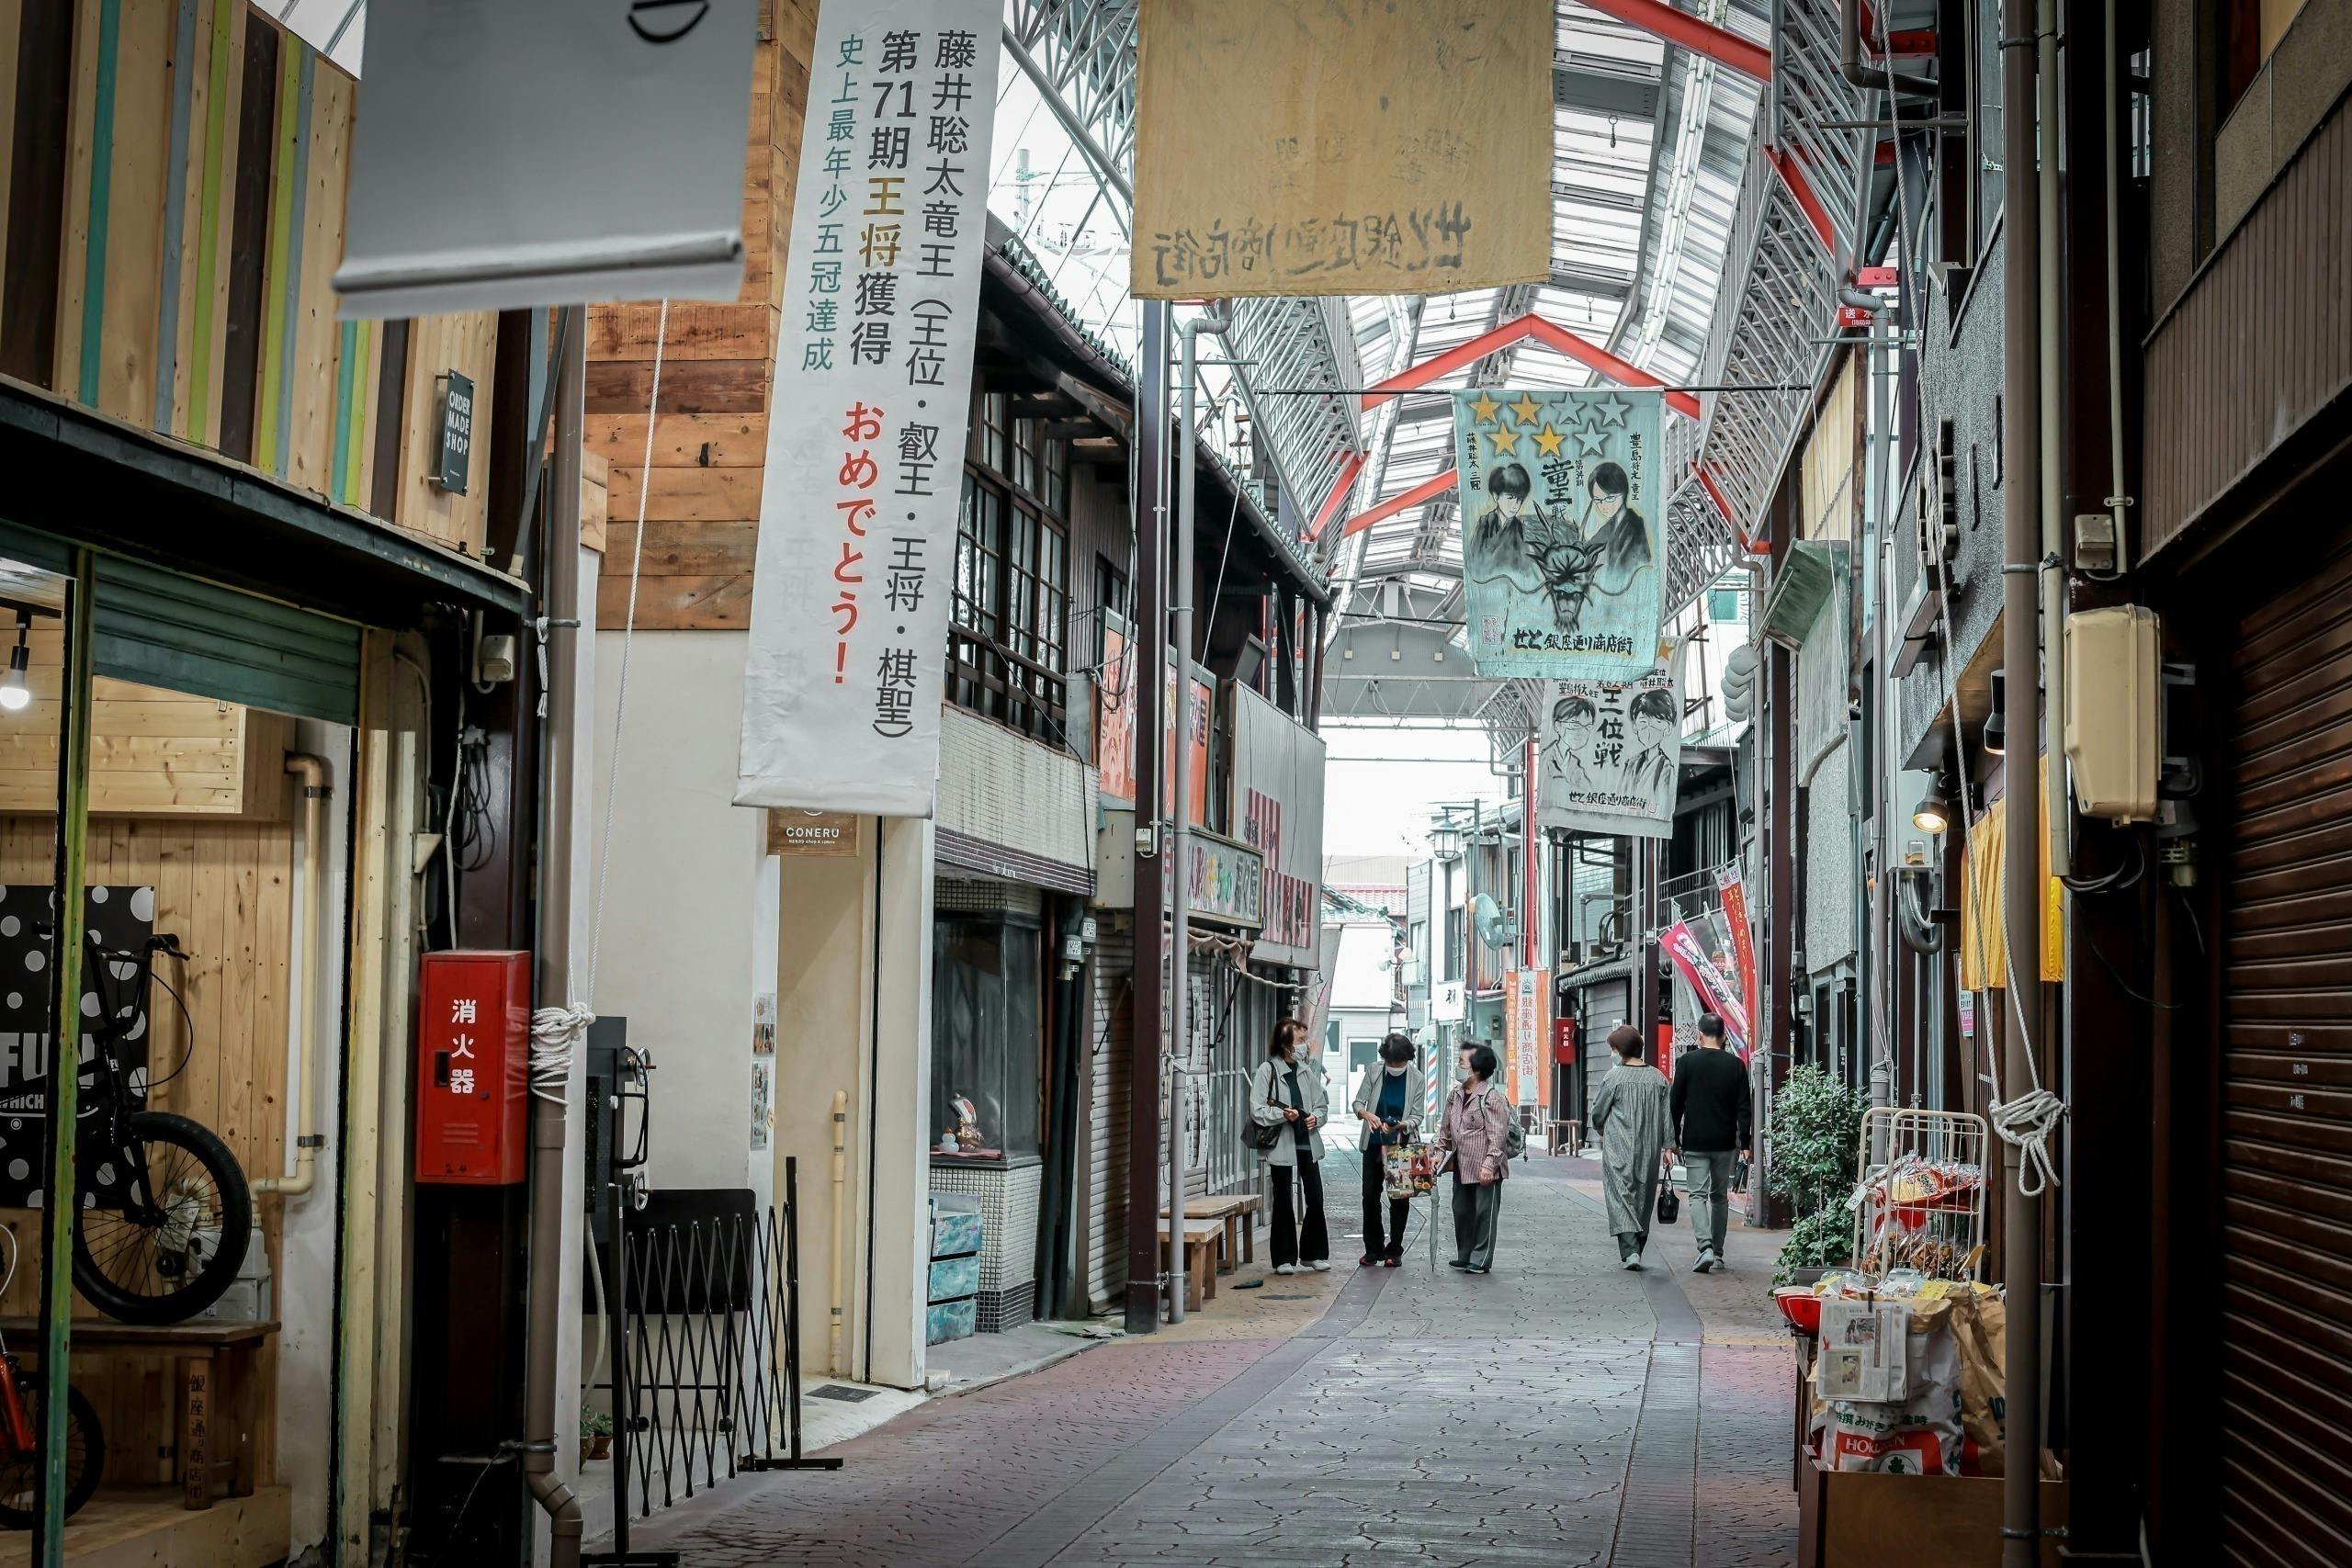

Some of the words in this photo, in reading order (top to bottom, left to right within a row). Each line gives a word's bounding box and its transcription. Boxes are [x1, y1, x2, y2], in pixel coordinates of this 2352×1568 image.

[801, 33, 865, 372] 史上最年少五冠達成
[1845, 309, 1873, 319] 送水
[449, 390, 470, 416] ORDER
[447, 410, 469, 435] MADE
[447, 431, 469, 456] SHOP
[1593, 688, 1624, 770] 王位戦
[786, 827, 840, 838] CONERU
[450, 998, 477, 1093] 消火器
